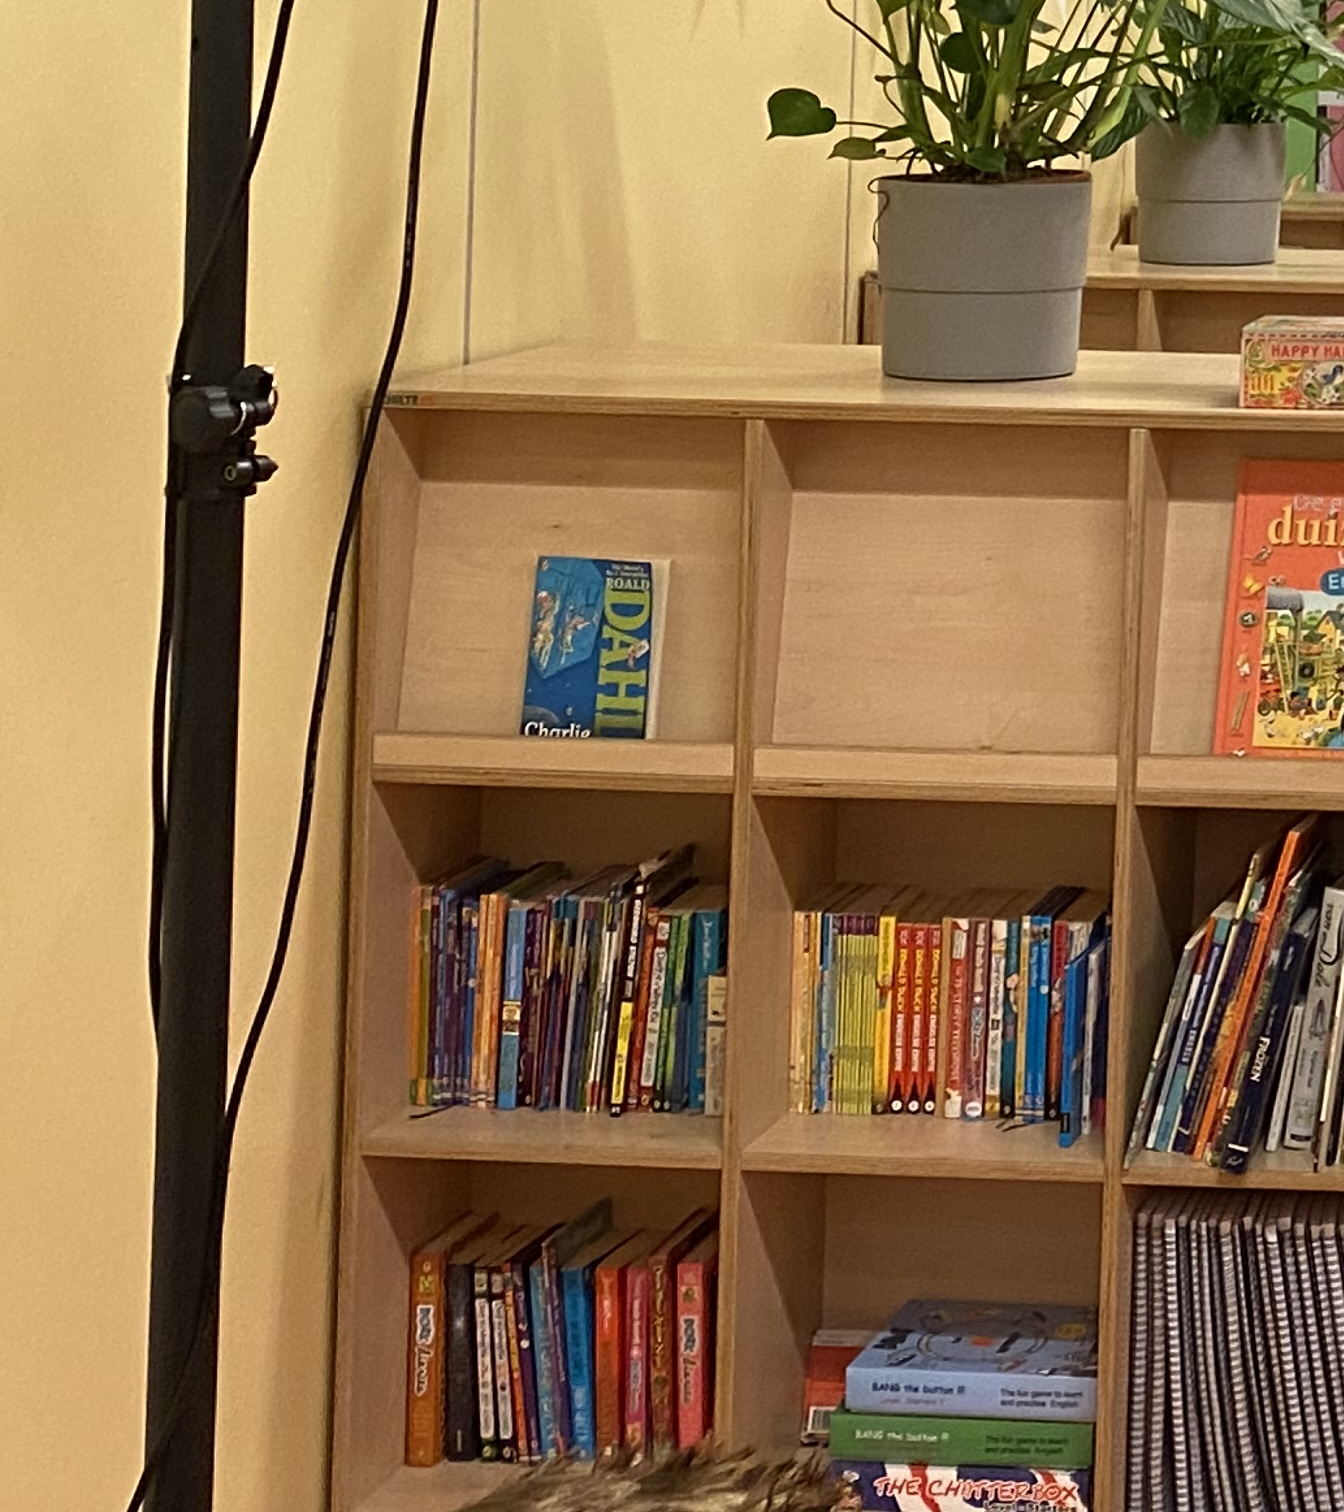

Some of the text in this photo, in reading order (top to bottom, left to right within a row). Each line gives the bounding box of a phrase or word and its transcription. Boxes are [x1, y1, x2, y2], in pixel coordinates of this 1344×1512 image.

[1271, 344, 1320, 358] HAPPY
[606, 577, 651, 589] ROALD
[594, 589, 650, 734] DAHL
[524, 720, 592, 738] Charlie
[1250, 1036, 1271, 1082] FROZEN
[873, 1475, 922, 1498] THE
